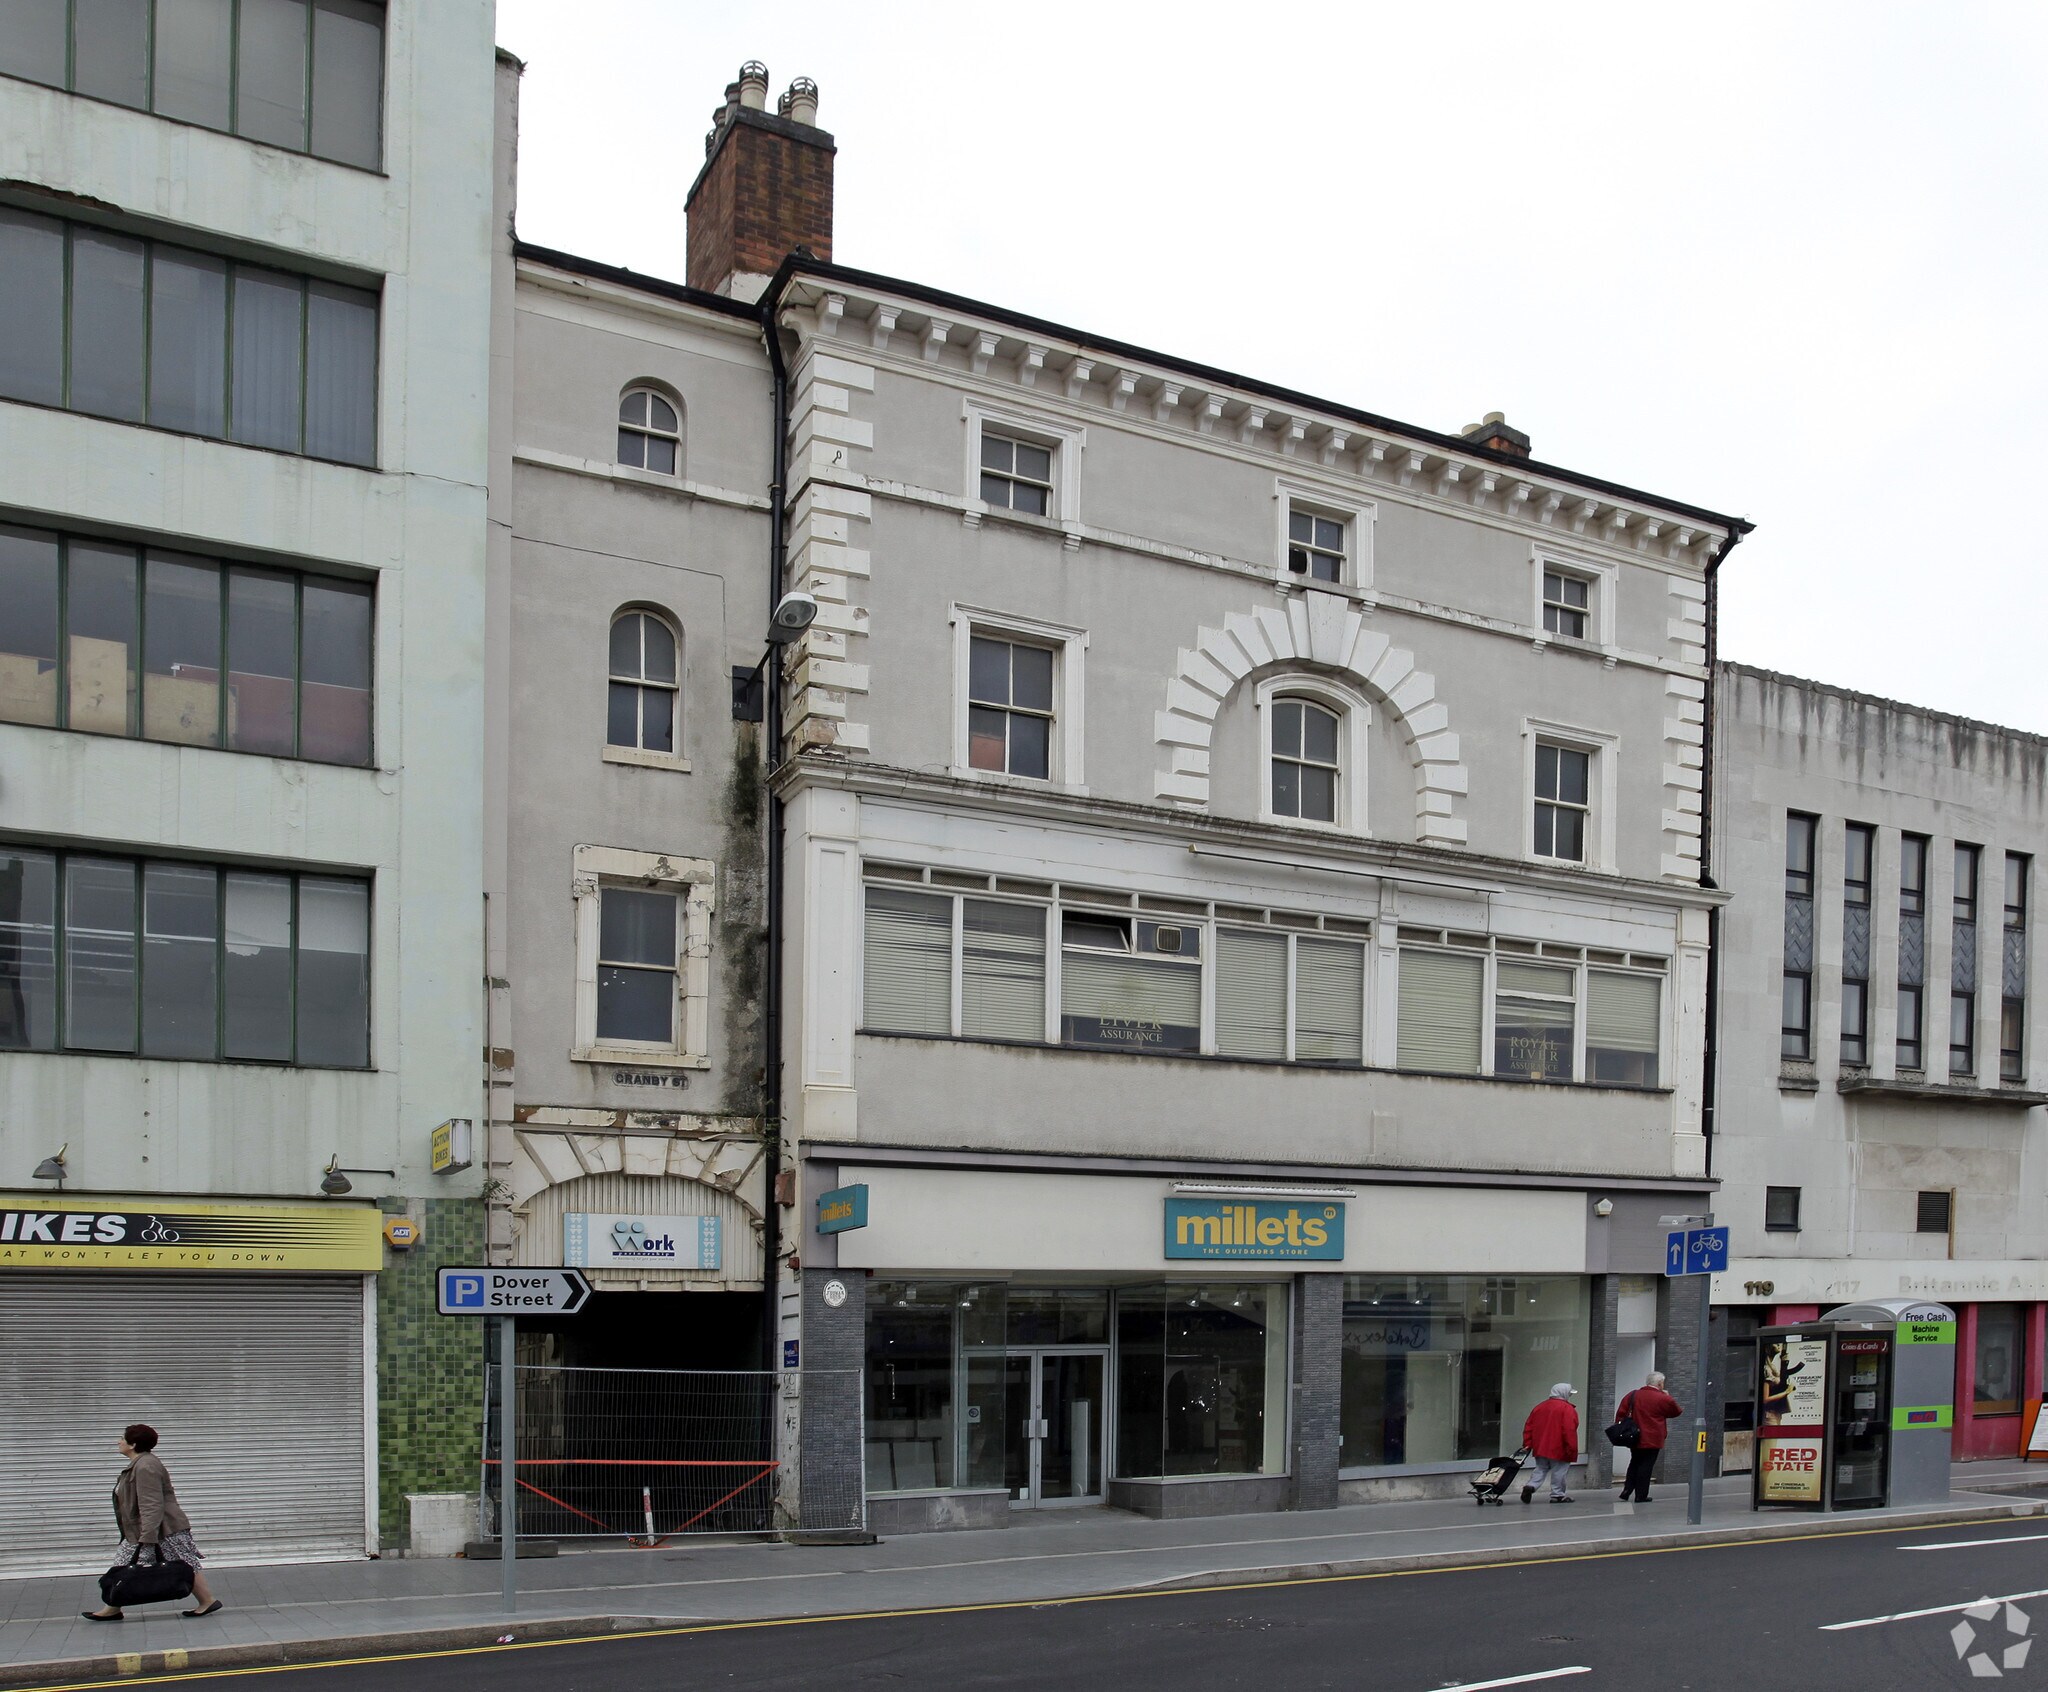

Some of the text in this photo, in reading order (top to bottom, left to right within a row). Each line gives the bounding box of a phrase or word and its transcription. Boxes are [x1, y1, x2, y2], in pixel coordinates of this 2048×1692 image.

[1099, 1029, 1163, 1043] ASSURANCE
[1510, 1036, 1558, 1051] ROYAL
[616, 1073, 669, 1087] GRANBY
[435, 1147, 449, 1163] BIKES
[820, 1201, 853, 1223] millets
[393, 1228, 410, 1237] ADT
[1176, 1205, 1328, 1247] millets
[43, 1250, 112, 1259] WON'T
[127, 1251, 164, 1260] LET
[179, 1252, 216, 1261] YOU
[231, 1253, 285, 1262] DOWN
[1225, 1248, 1275, 1256] OUTDOORS
[1279, 1248, 1309, 1256] STORE
[492, 1275, 550, 1289] Dover
[1744, 1280, 1775, 1296] 119
[455, 1278, 479, 1305] P
[490, 1292, 554, 1306] Street
[1905, 1312, 1947, 1322] Free Cash
[1911, 1325, 1940, 1333] Machine
[1913, 1334, 1938, 1342] Service
[1862, 1342, 1878, 1350] Cards
[1769, 1448, 1818, 1462] RED
[1761, 1461, 1815, 1472] STATE
